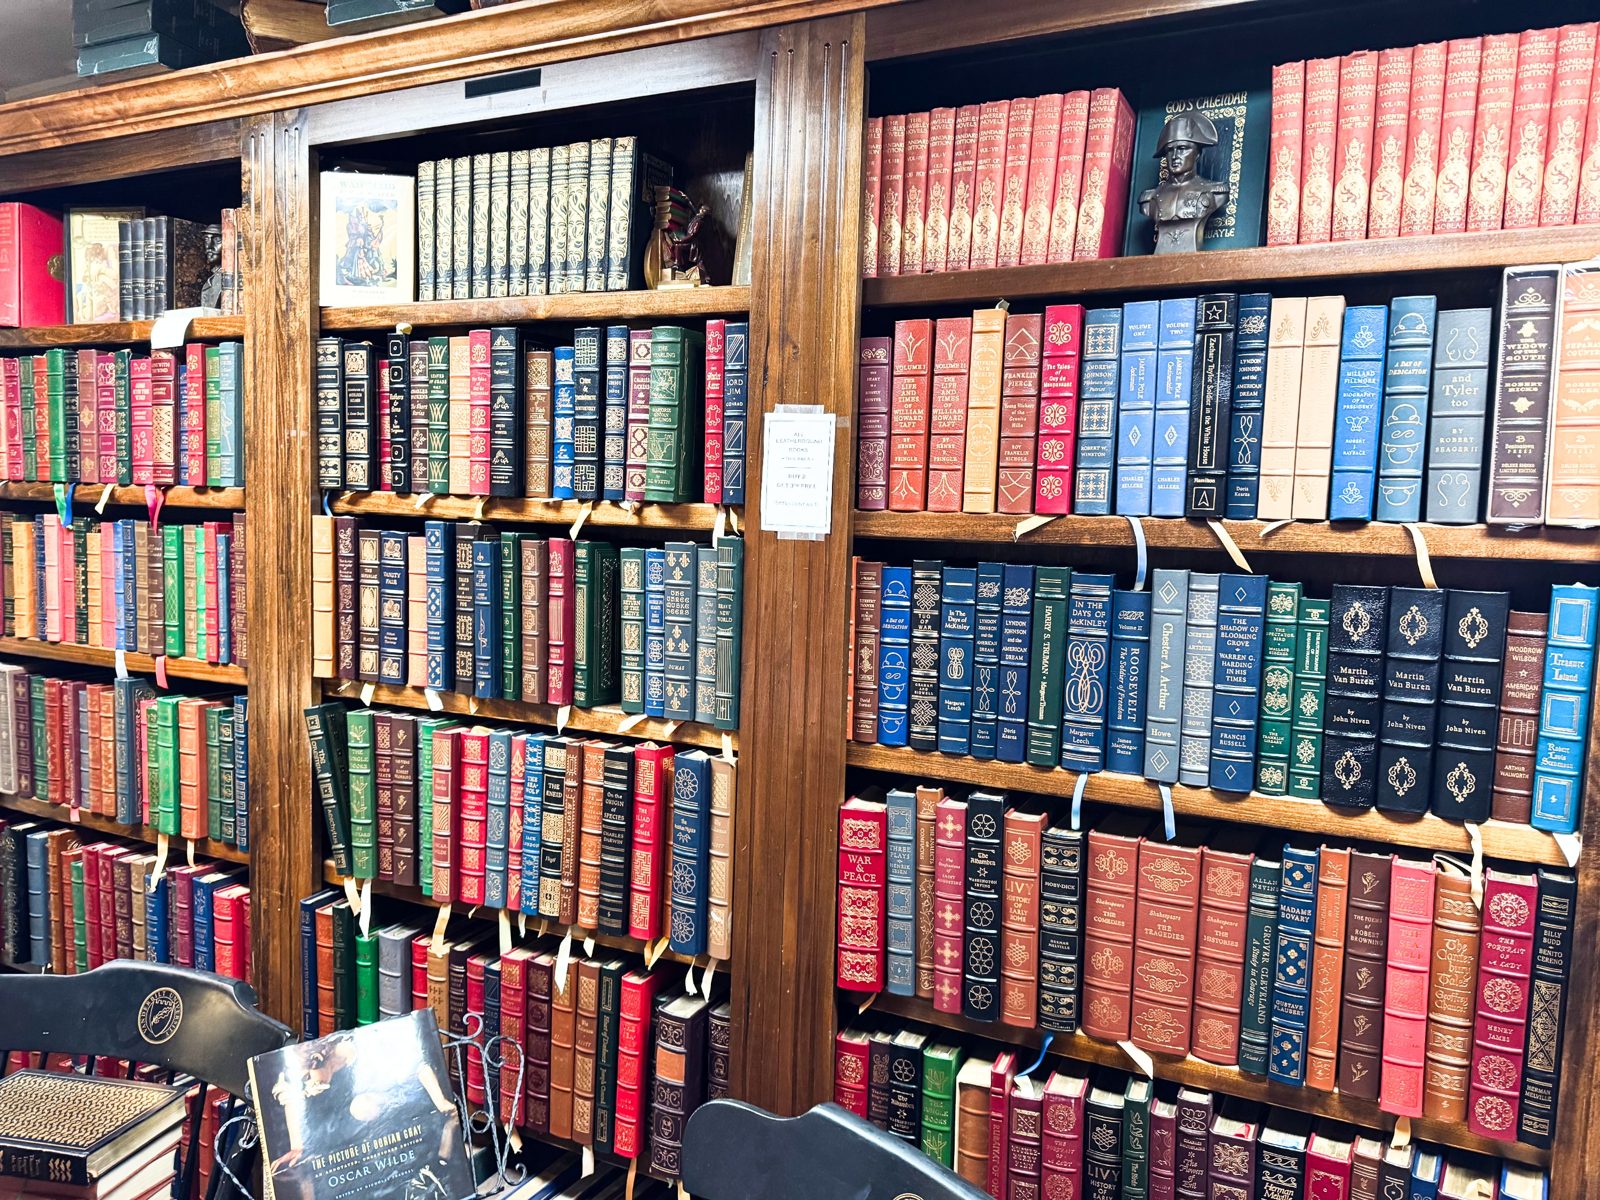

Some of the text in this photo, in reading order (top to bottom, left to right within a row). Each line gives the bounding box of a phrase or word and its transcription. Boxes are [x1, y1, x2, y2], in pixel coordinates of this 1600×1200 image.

[1344, 72, 1373, 80] NOVELS
[1196, 91, 1247, 109] CALENDAR
[1207, 361, 1215, 383] Taylor
[1452, 374, 1471, 382] and
[1442, 385, 1478, 397] Tyler
[1203, 425, 1211, 445] White
[1202, 446, 1210, 464] House
[1043, 605, 1052, 632] HARRY
[1070, 619, 1107, 627] McKINLEY
[1042, 642, 1050, 675] TRUMAN
[1550, 653, 1584, 668] Treasure
[1119, 659, 1127, 682] Soldier
[1159, 623, 1173, 710] Chester A. Arthur
[1340, 667, 1367, 675] Martin
[1396, 672, 1424, 680] Martin
[1455, 675, 1484, 684] Martin
[1128, 648, 1140, 723] ROOSEVELT
[1406, 682, 1430, 690] Buren
[1069, 728, 1094, 737] Margaret
[1152, 729, 1171, 737] Howe
[848, 855, 871, 864] WAR
[856, 864, 864, 872] &
[844, 872, 876, 882] PEACE
[1006, 880, 1034, 894] LIVY
[1007, 896, 1030, 904] HISTORY
[1281, 905, 1312, 915] MADAME
[1281, 913, 1310, 922] BOVARY
[1144, 928, 1184, 940] TRAGEDIES
[1251, 947, 1260, 967] Study
[1539, 948, 1562, 957] BENITO
[1537, 956, 1562, 965] CERENO
[1248, 977, 1258, 1006] Courage
[1488, 1025, 1513, 1034] HENRY
[1488, 1034, 1510, 1042] JAMES
[312, 1124, 422, 1170] THE PICTURE OF DORIAN GRAY
[329, 1150, 415, 1187] OSCAR WILDE
[1088, 1168, 1121, 1182] LIVY
[1090, 1179, 1116, 1191] HISTORY
